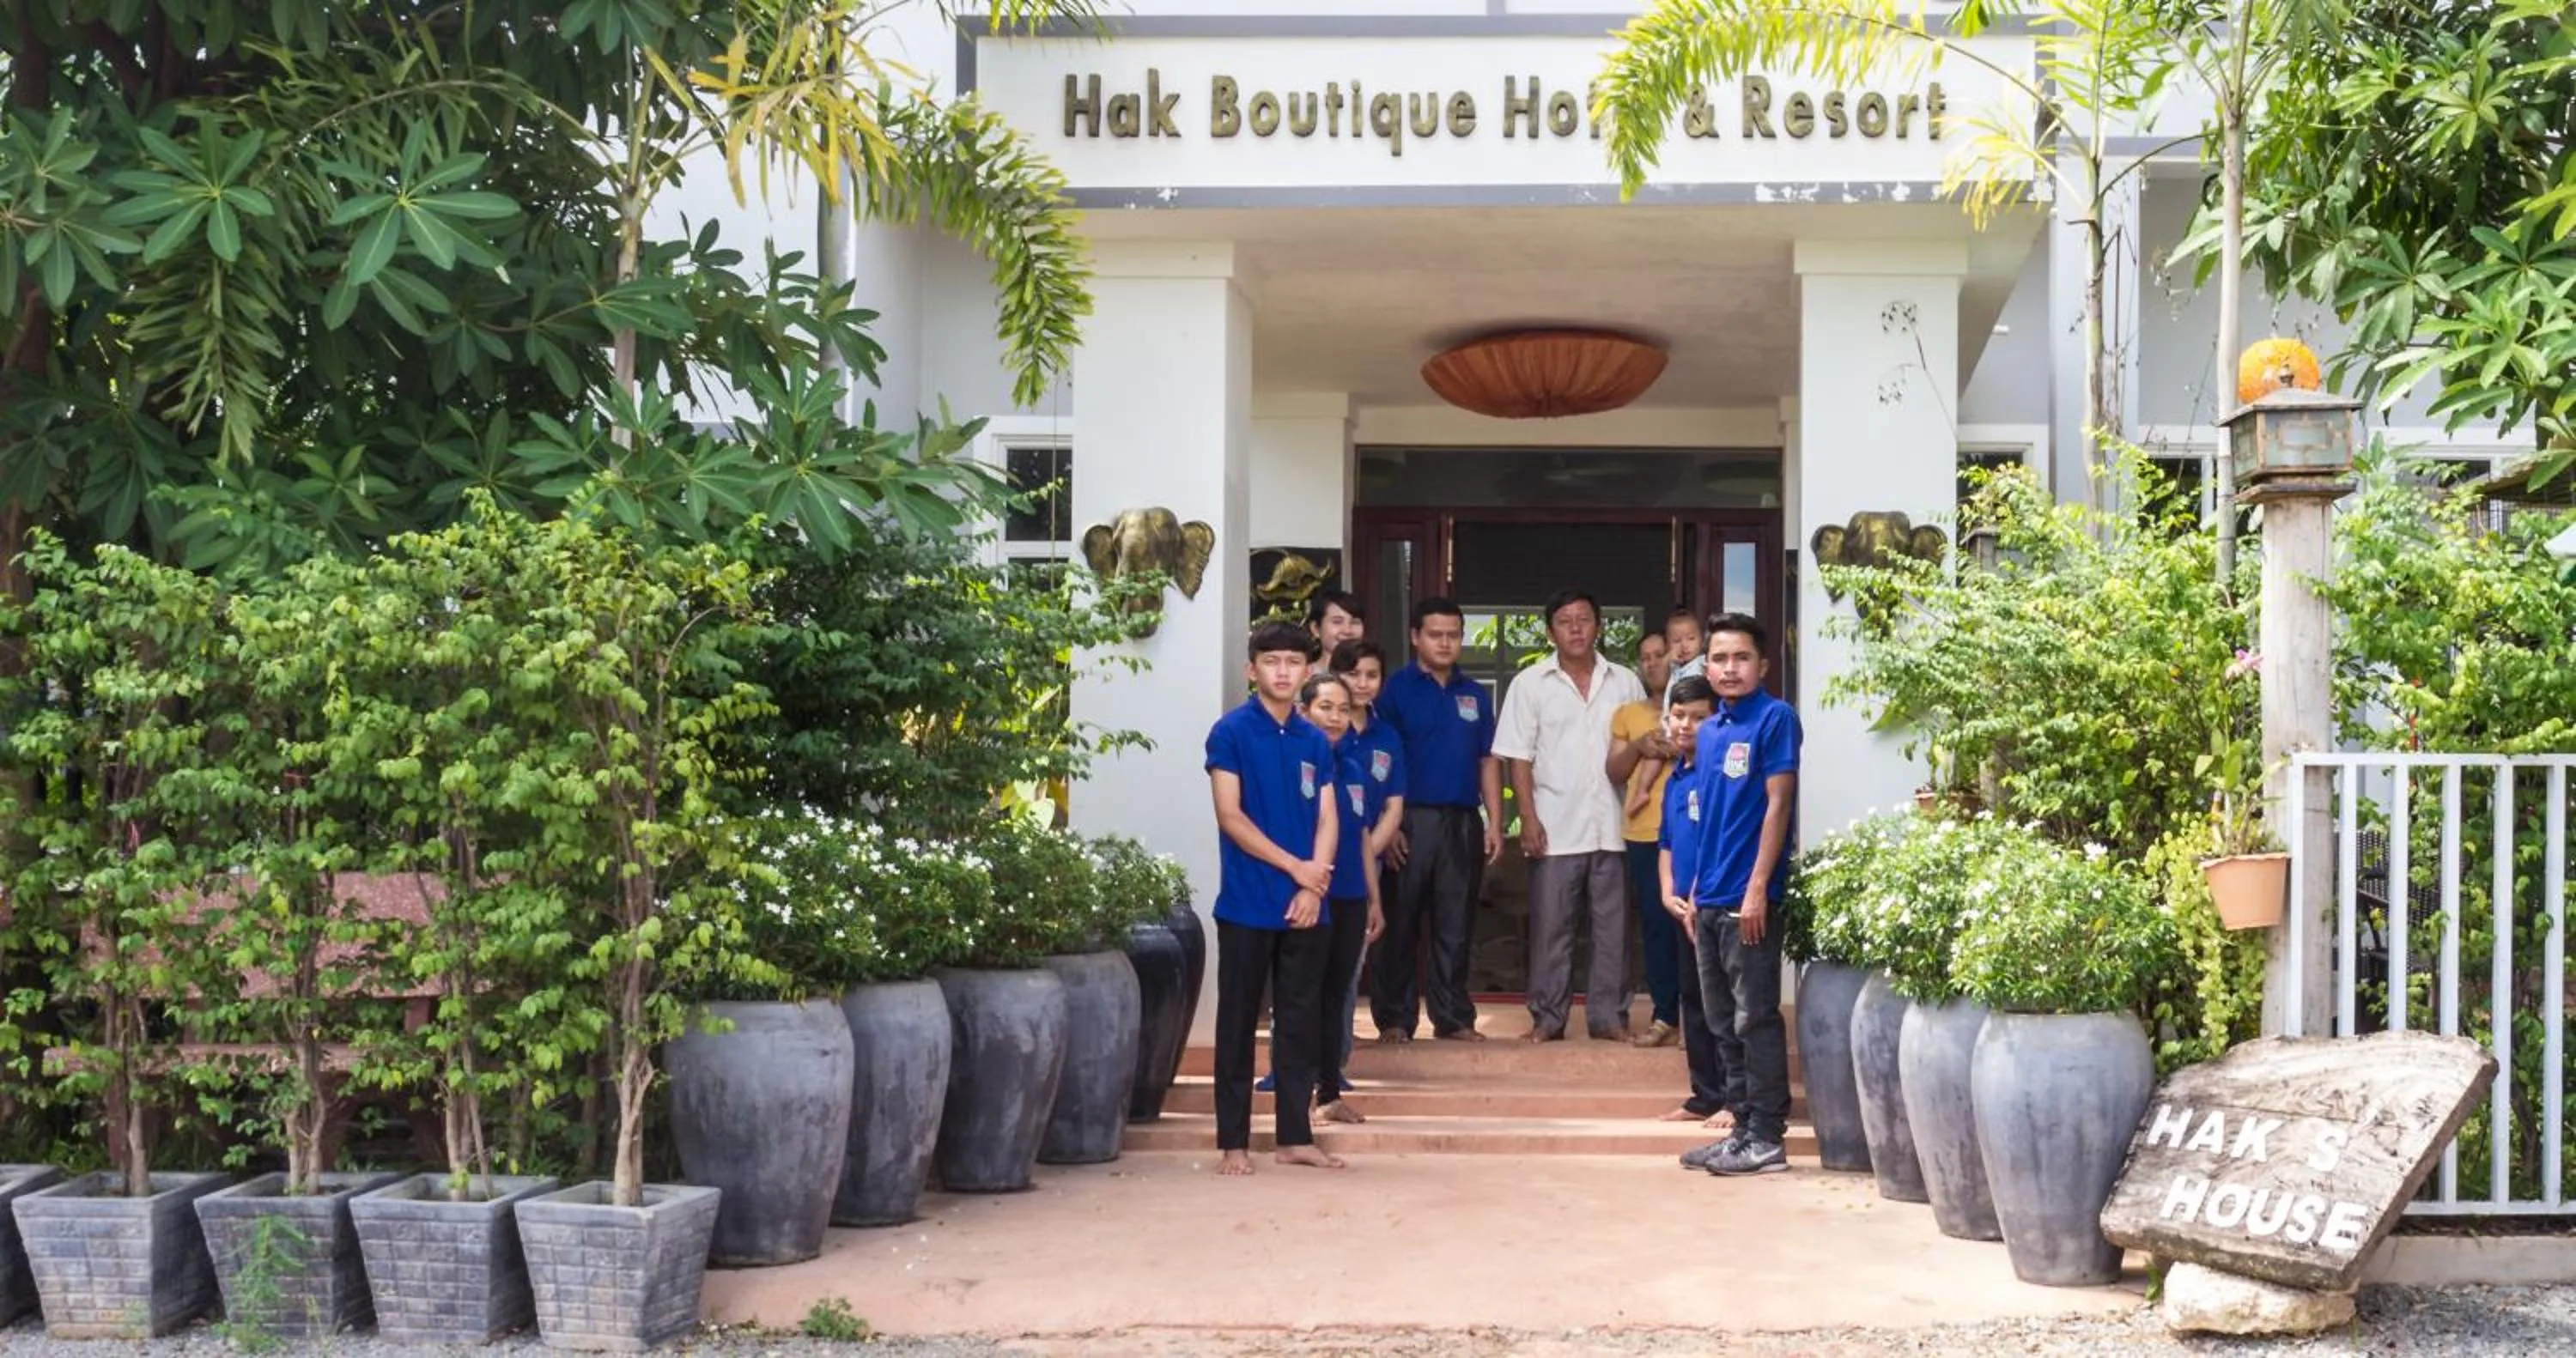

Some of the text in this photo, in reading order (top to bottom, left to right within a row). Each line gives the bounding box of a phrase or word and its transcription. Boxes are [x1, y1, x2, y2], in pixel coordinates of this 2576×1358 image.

[1064, 69, 1182, 137] Hak
[1211, 74, 1477, 156] Boutique
[1684, 82, 1720, 139] &
[1741, 74, 1947, 139] Resort
[2148, 1104, 2281, 1162] HAK
[2160, 1176, 2367, 1250] HOUSE
